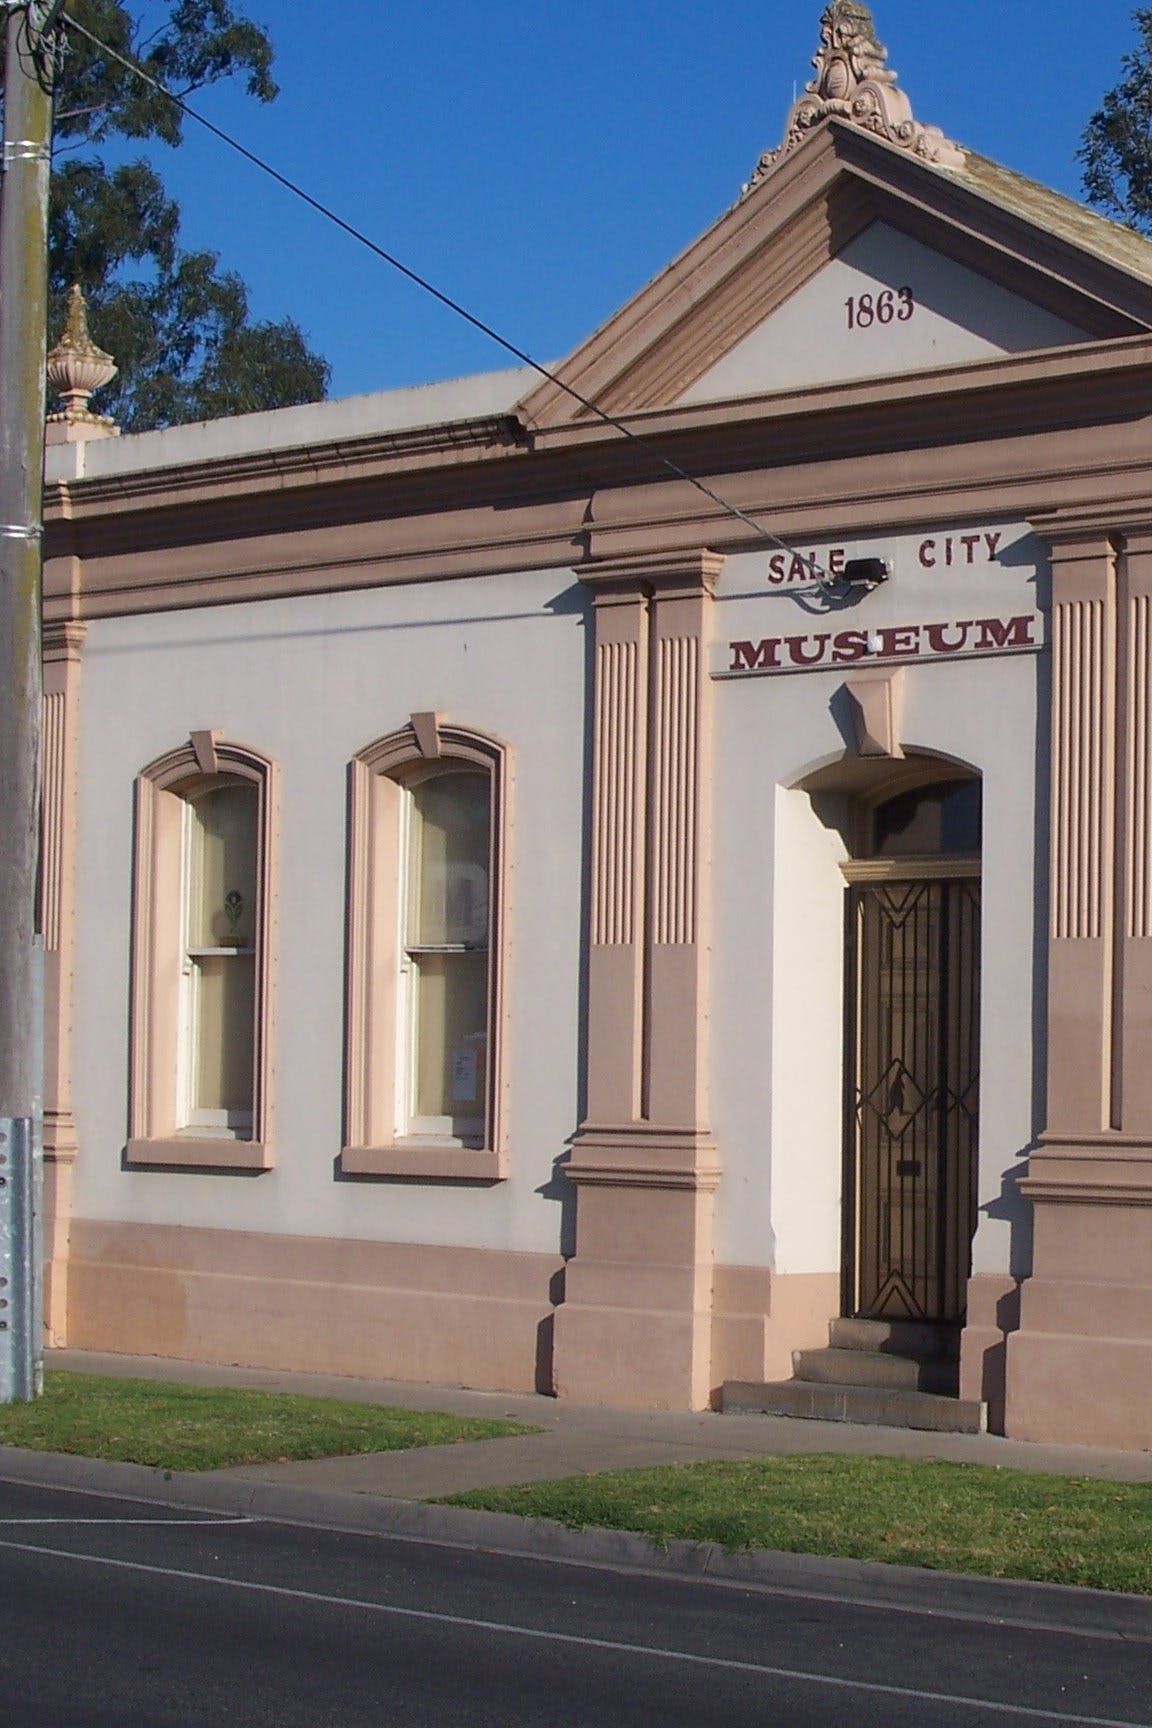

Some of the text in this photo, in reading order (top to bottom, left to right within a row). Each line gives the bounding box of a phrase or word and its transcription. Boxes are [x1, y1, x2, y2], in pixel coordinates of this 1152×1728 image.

[844, 286, 914, 329] 1863
[918, 533, 1001, 568] CITY
[729, 615, 1035, 670] MUSEUM
